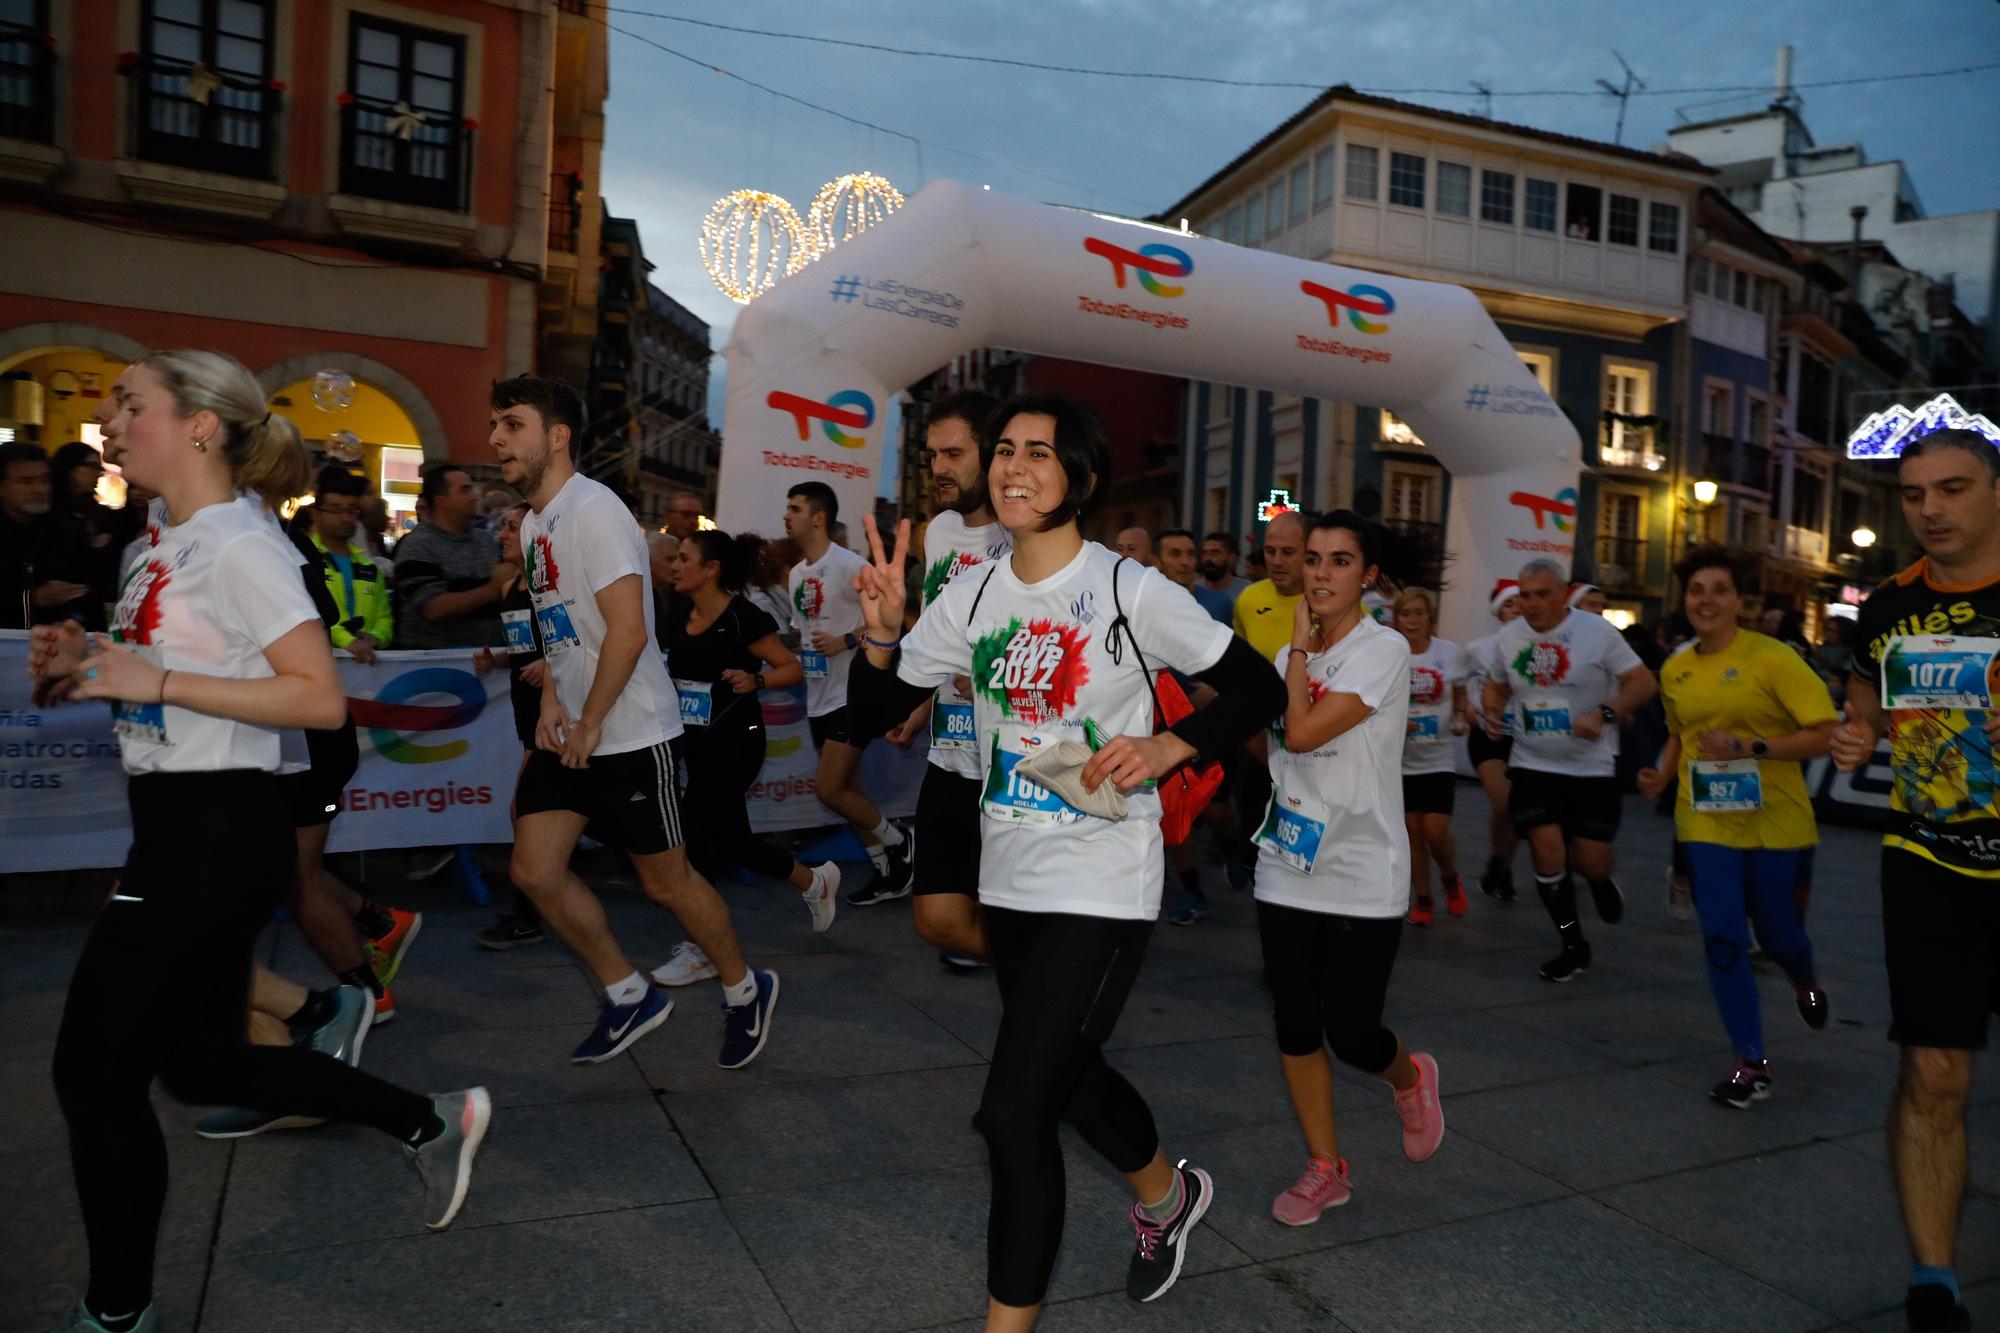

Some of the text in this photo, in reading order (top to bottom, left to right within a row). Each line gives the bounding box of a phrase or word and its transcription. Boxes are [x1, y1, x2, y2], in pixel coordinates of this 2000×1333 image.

[1077, 295, 1189, 329] TotalEnergies
[1296, 335, 1393, 363] TotalEnergies
[762, 448, 870, 479] TotalEnergies
[988, 657, 1053, 690] 2022
[1908, 662, 1964, 688] 1077
[1011, 697, 1047, 709] SILVESTRE
[1026, 690, 1044, 701] SAN
[947, 714, 973, 733] 864
[747, 776, 816, 802] ergies
[1709, 781, 1738, 797] 957
[1013, 800, 1038, 809] NOELIA
[1276, 817, 1302, 846] 865
